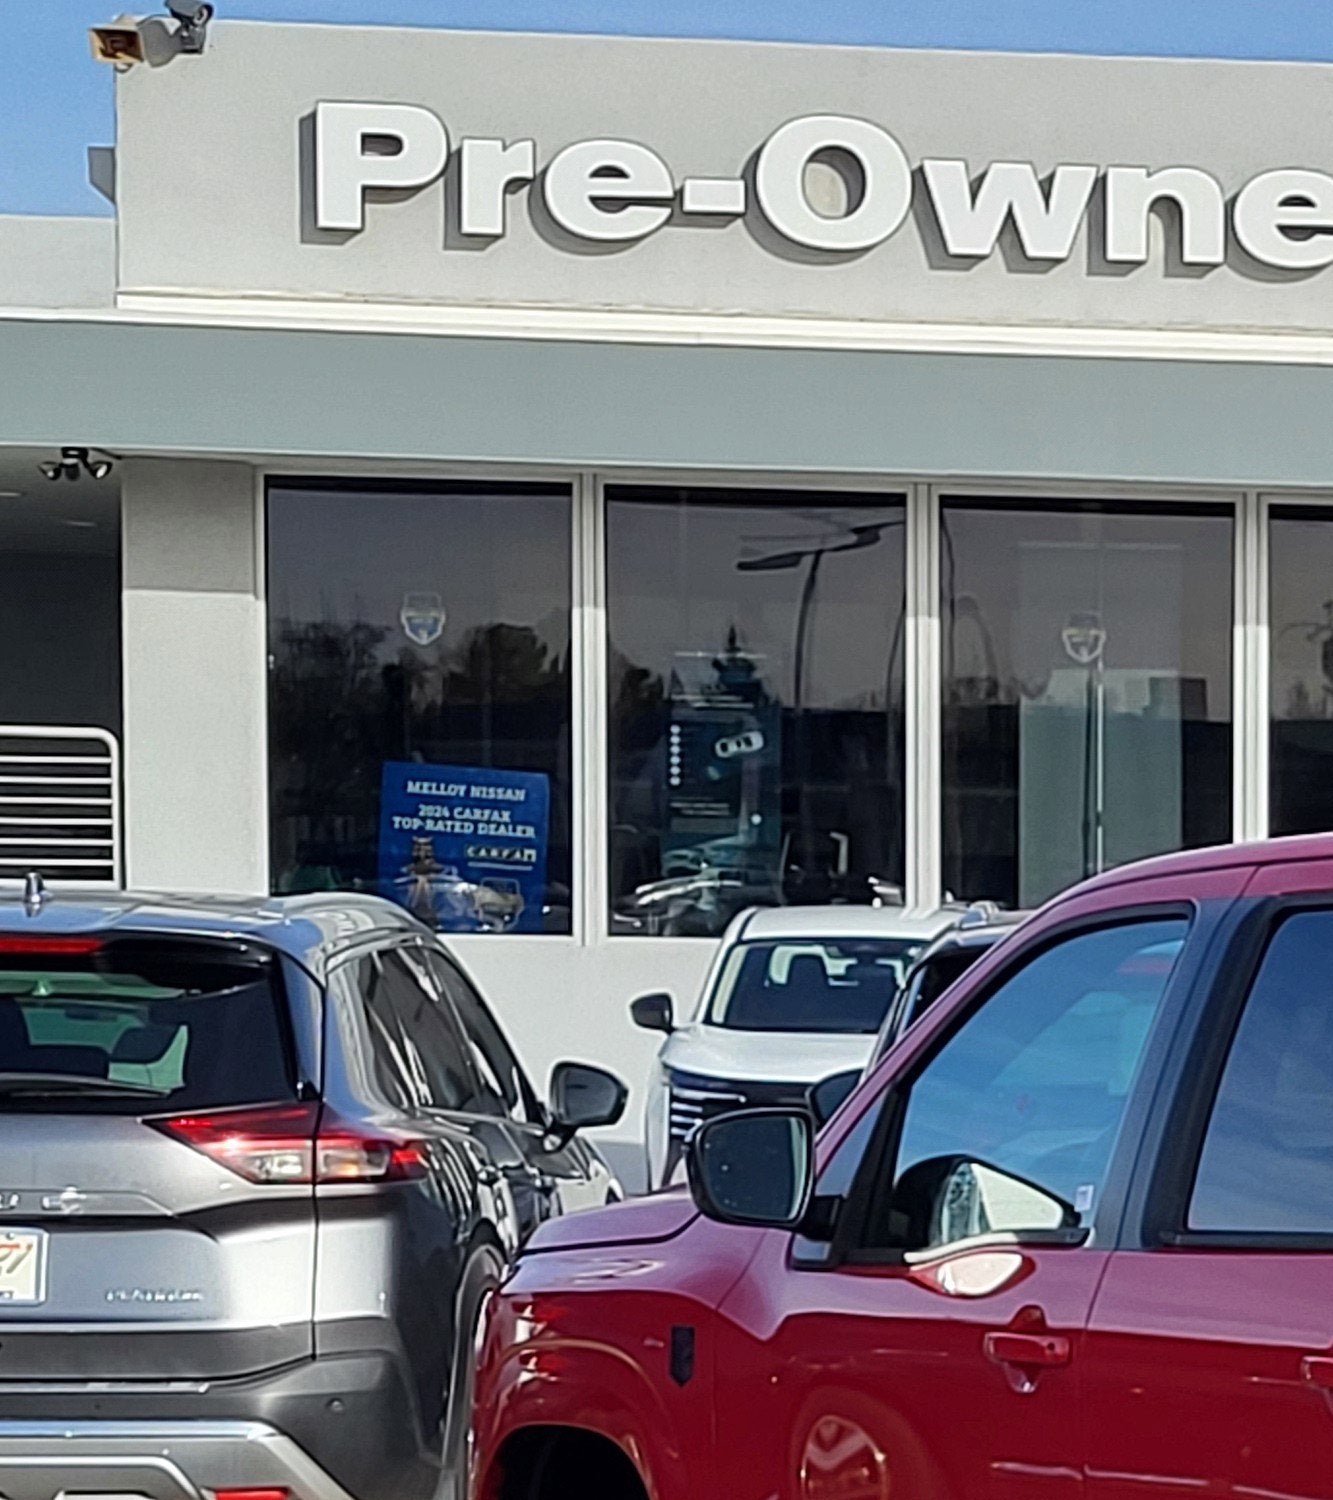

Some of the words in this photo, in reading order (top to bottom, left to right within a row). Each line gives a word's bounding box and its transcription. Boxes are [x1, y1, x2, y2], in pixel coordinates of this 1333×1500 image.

[406, 780, 467, 798] MELLOY
[470, 784, 526, 802] NISSAN
[418, 803, 451, 818] 2024
[453, 806, 512, 823] CARFAX
[392, 816, 474, 835] TOP-RATED
[477, 822, 536, 839] DEALER
